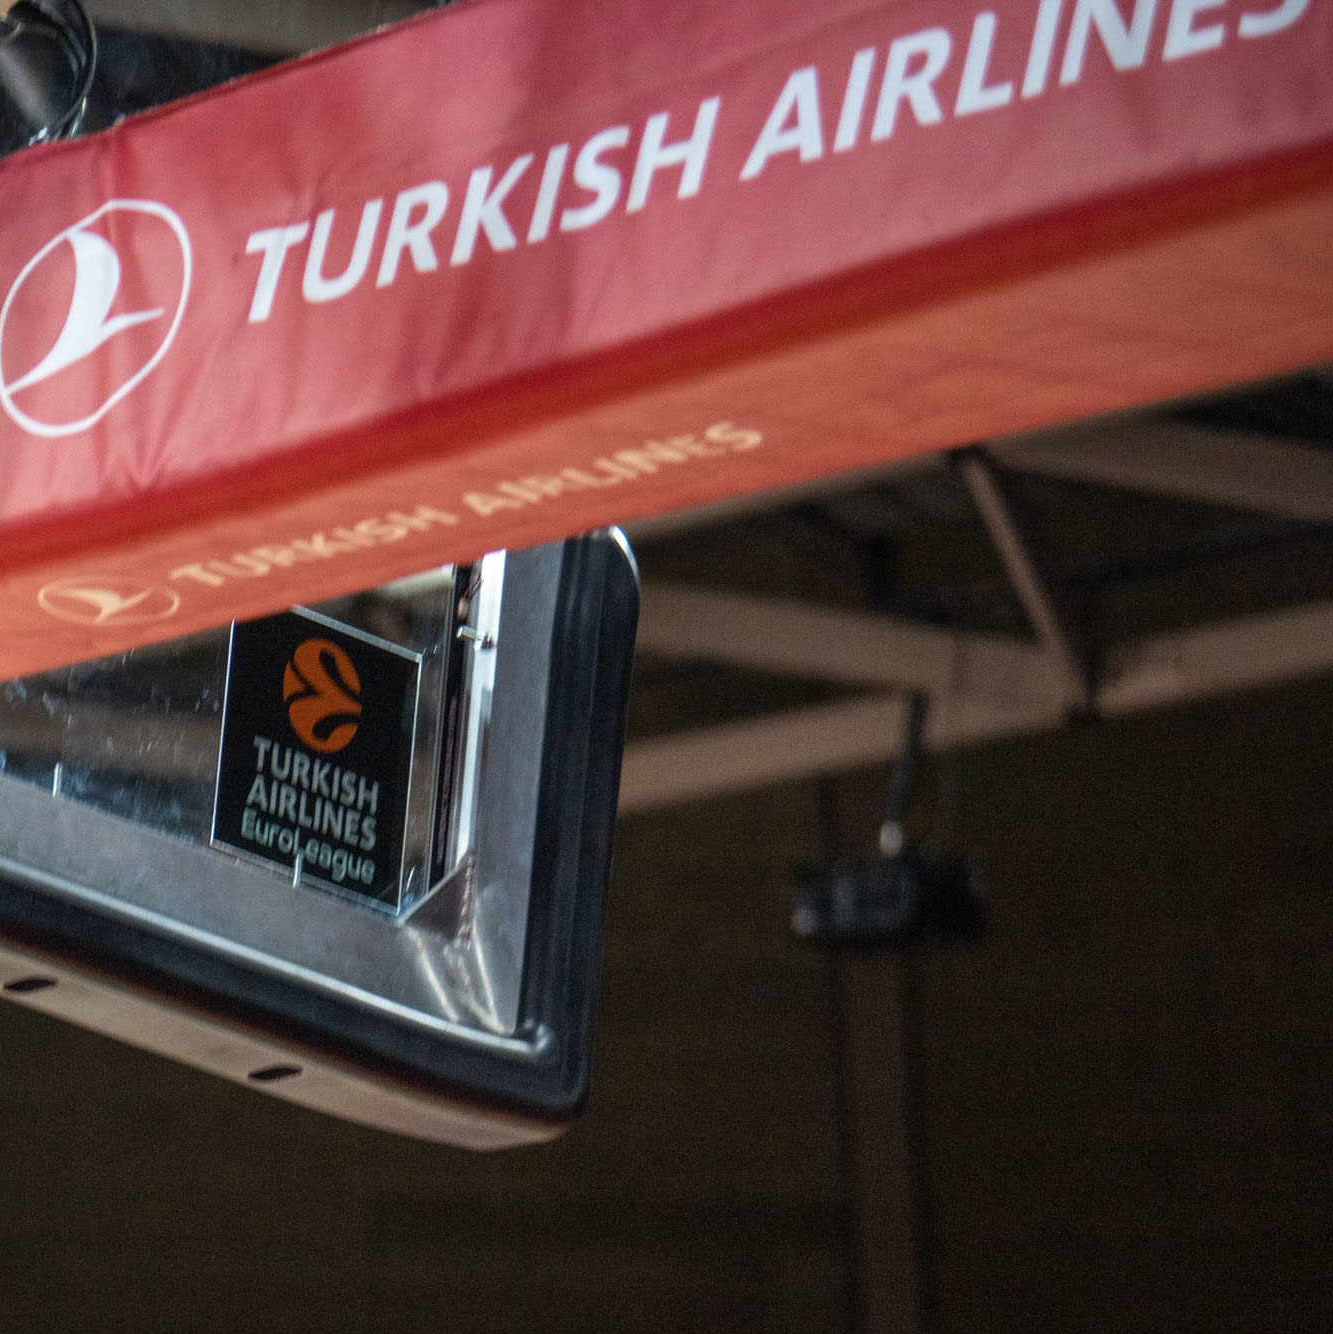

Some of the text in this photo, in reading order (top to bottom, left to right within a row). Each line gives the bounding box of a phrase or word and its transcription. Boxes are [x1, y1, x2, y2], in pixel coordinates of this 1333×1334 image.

[245, 96, 721, 324] TURKISH
[170, 420, 763, 588] TURKISH AIRLINES
[245, 773, 376, 851] AIRLINES
[252, 735, 379, 815] TURKISH
[240, 807, 375, 885] EuroLeague
